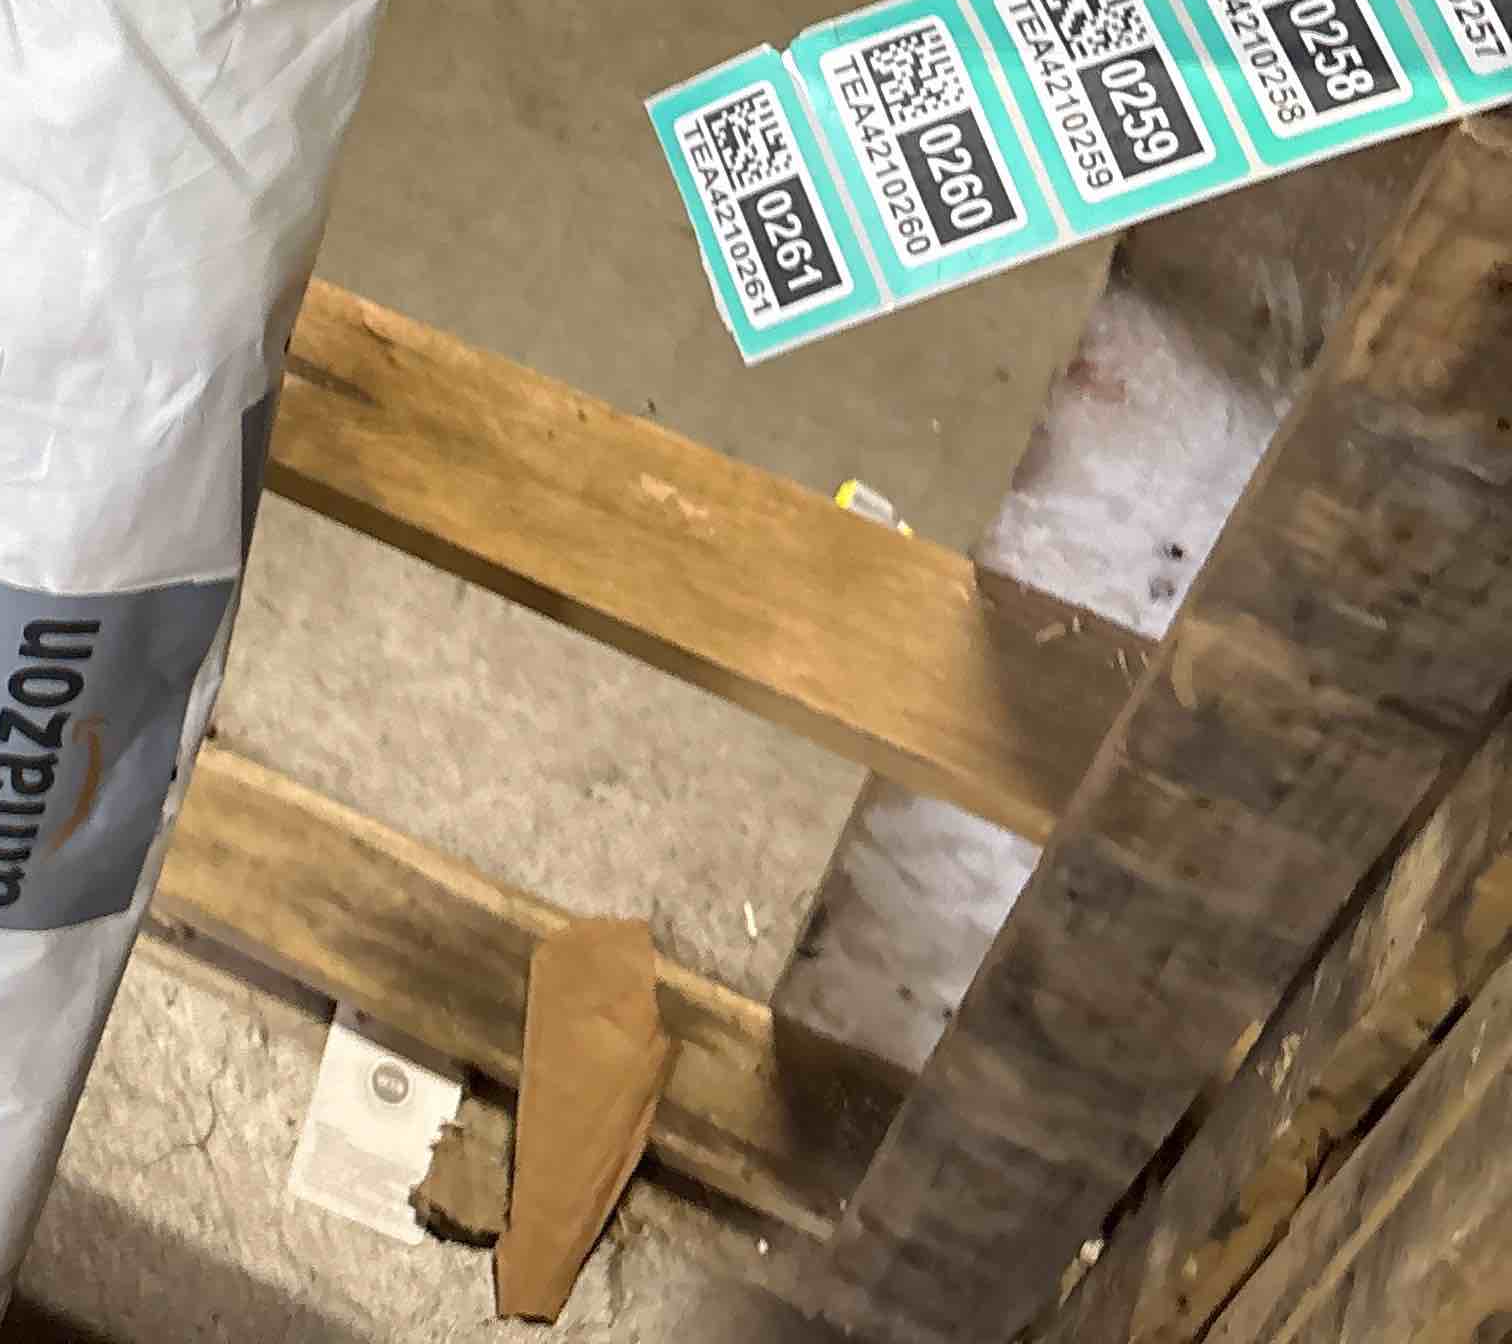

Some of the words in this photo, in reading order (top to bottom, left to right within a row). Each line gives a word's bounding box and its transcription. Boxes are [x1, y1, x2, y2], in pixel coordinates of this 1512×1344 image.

[833, 53, 932, 256] TEA4210260
[1099, 58, 1179, 164] 0259
[684, 119, 773, 315] TEA4210261
[918, 123, 994, 231] 0260
[755, 188, 824, 293] 0261
